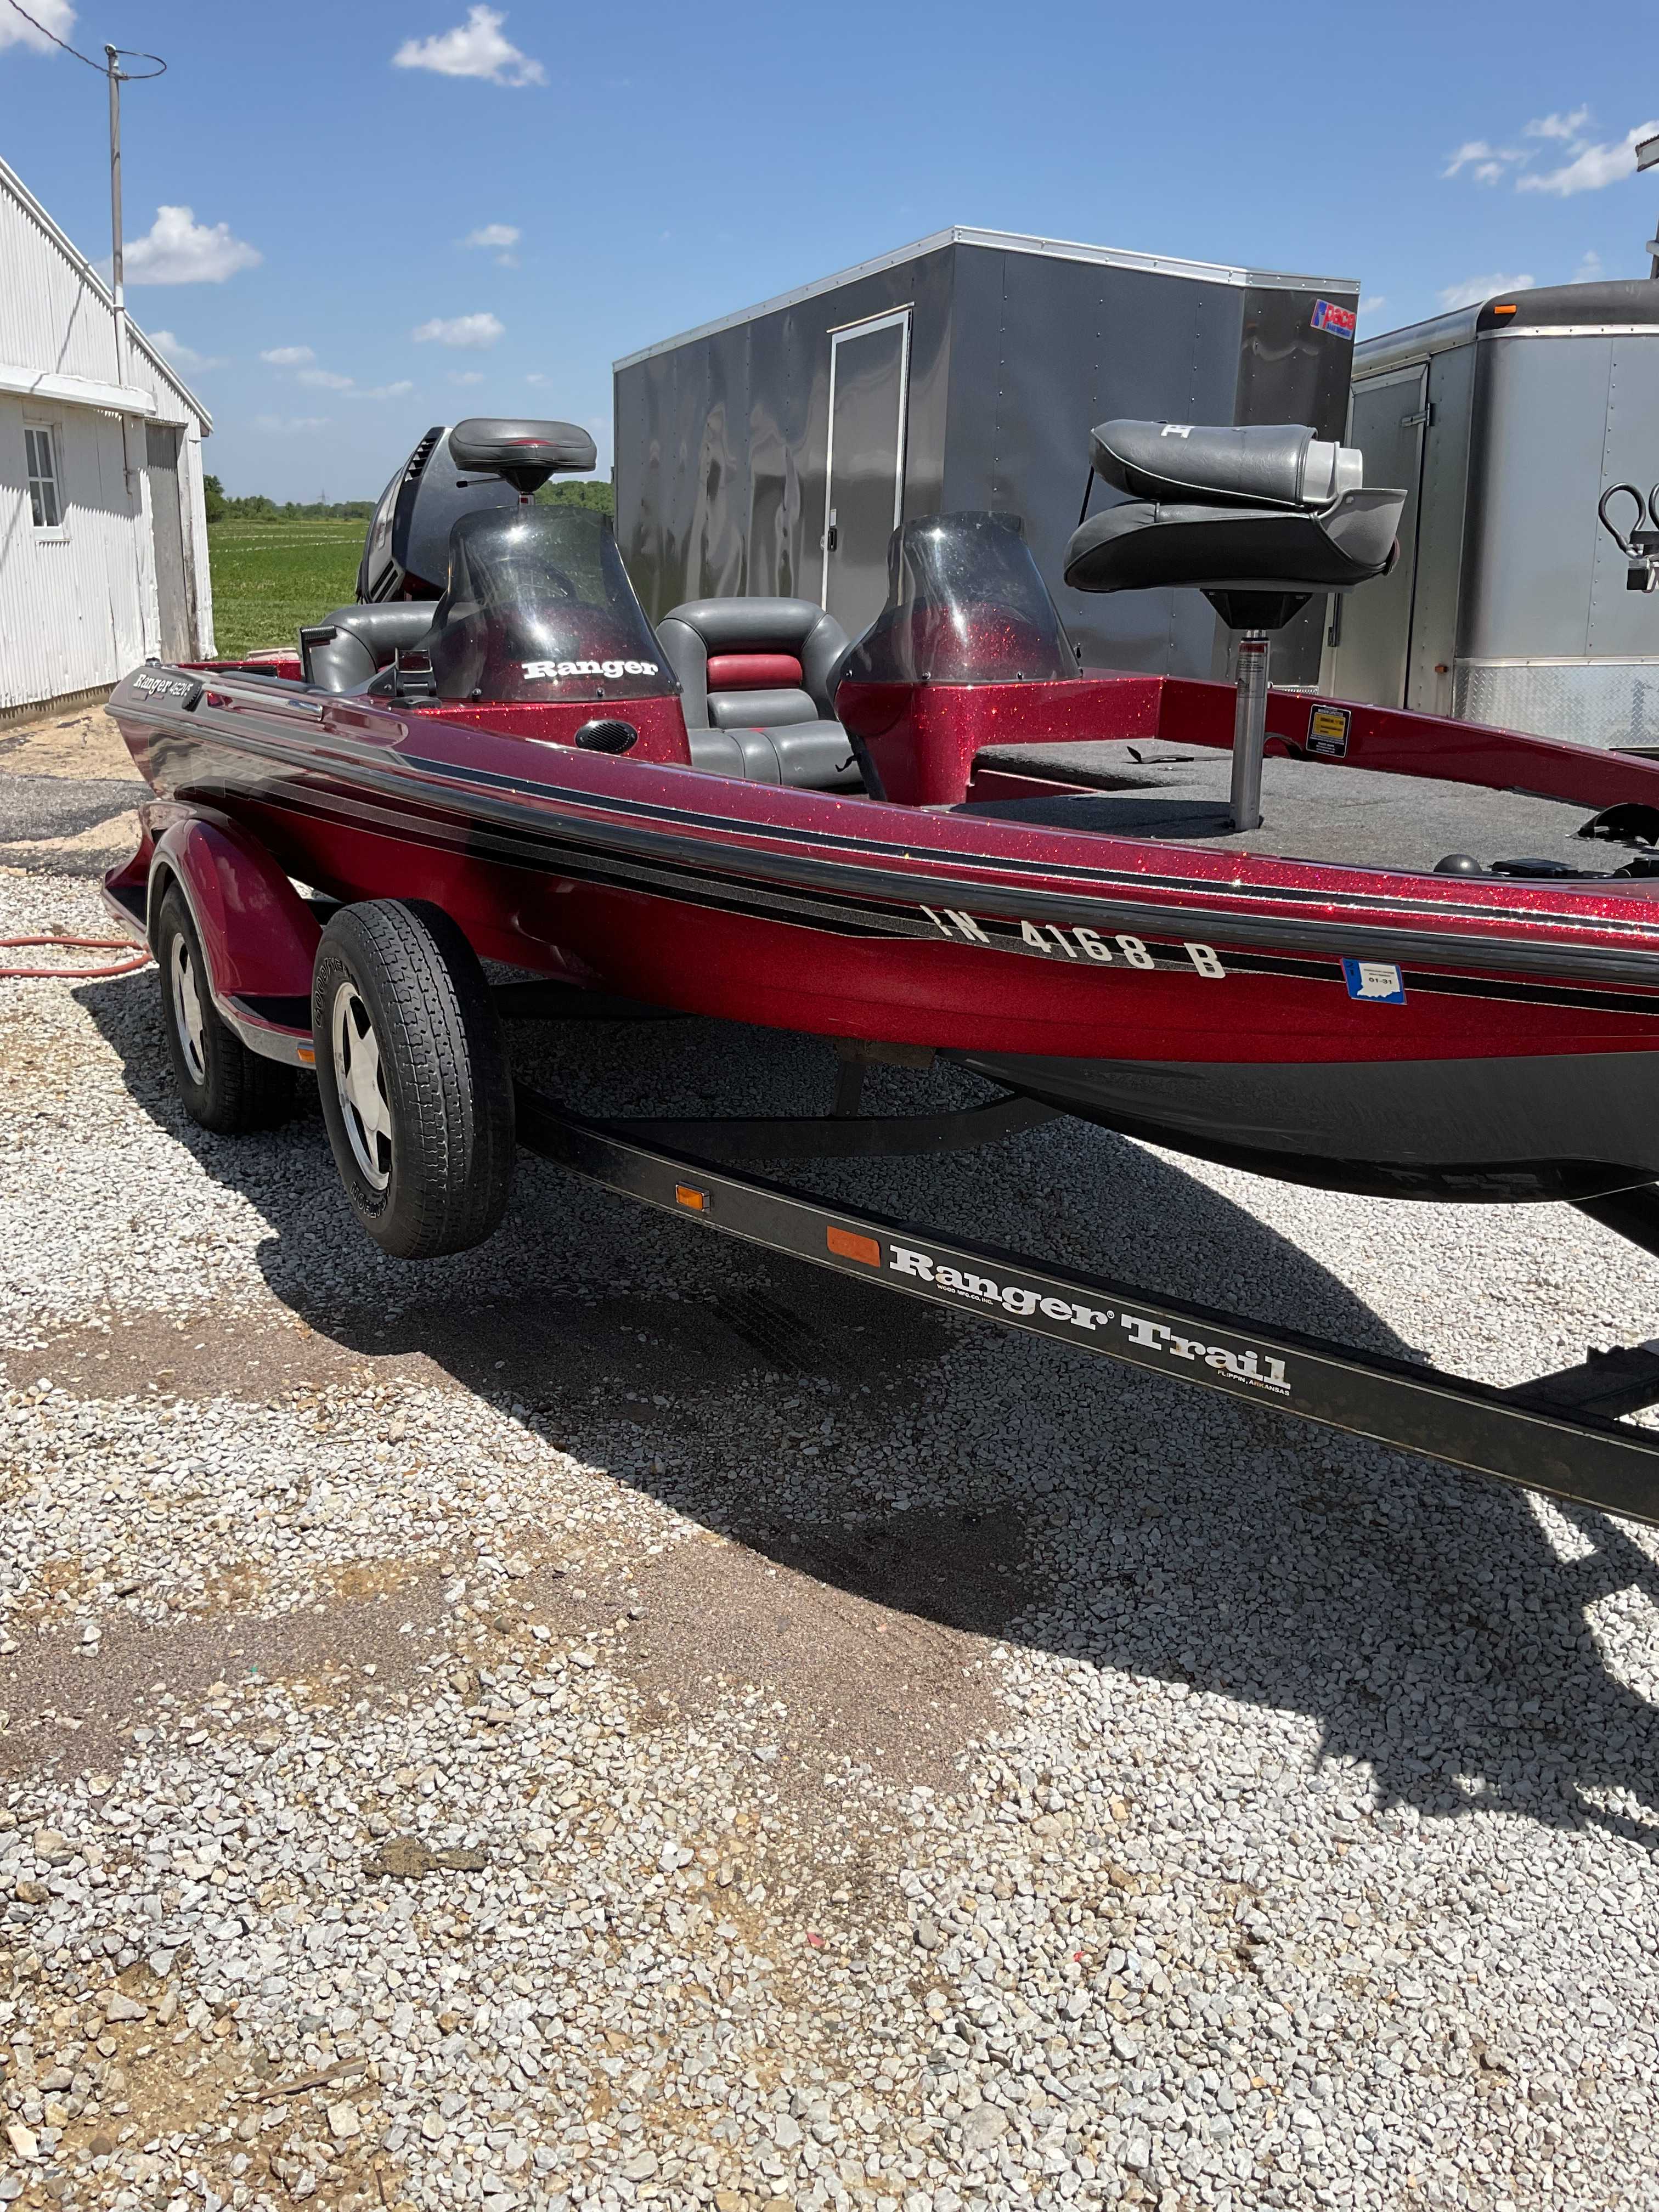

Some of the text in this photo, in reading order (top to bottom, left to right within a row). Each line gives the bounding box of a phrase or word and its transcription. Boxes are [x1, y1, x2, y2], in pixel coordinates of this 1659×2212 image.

[520, 659, 658, 679] Ranger
[133, 674, 172, 695] Ranger
[921, 905, 1226, 979] IN 4168 B
[936, 1284, 956, 1294] WOOD
[889, 1244, 1291, 1390] Ranger Trail
[1249, 1379, 1290, 1396] ARKANSAS
